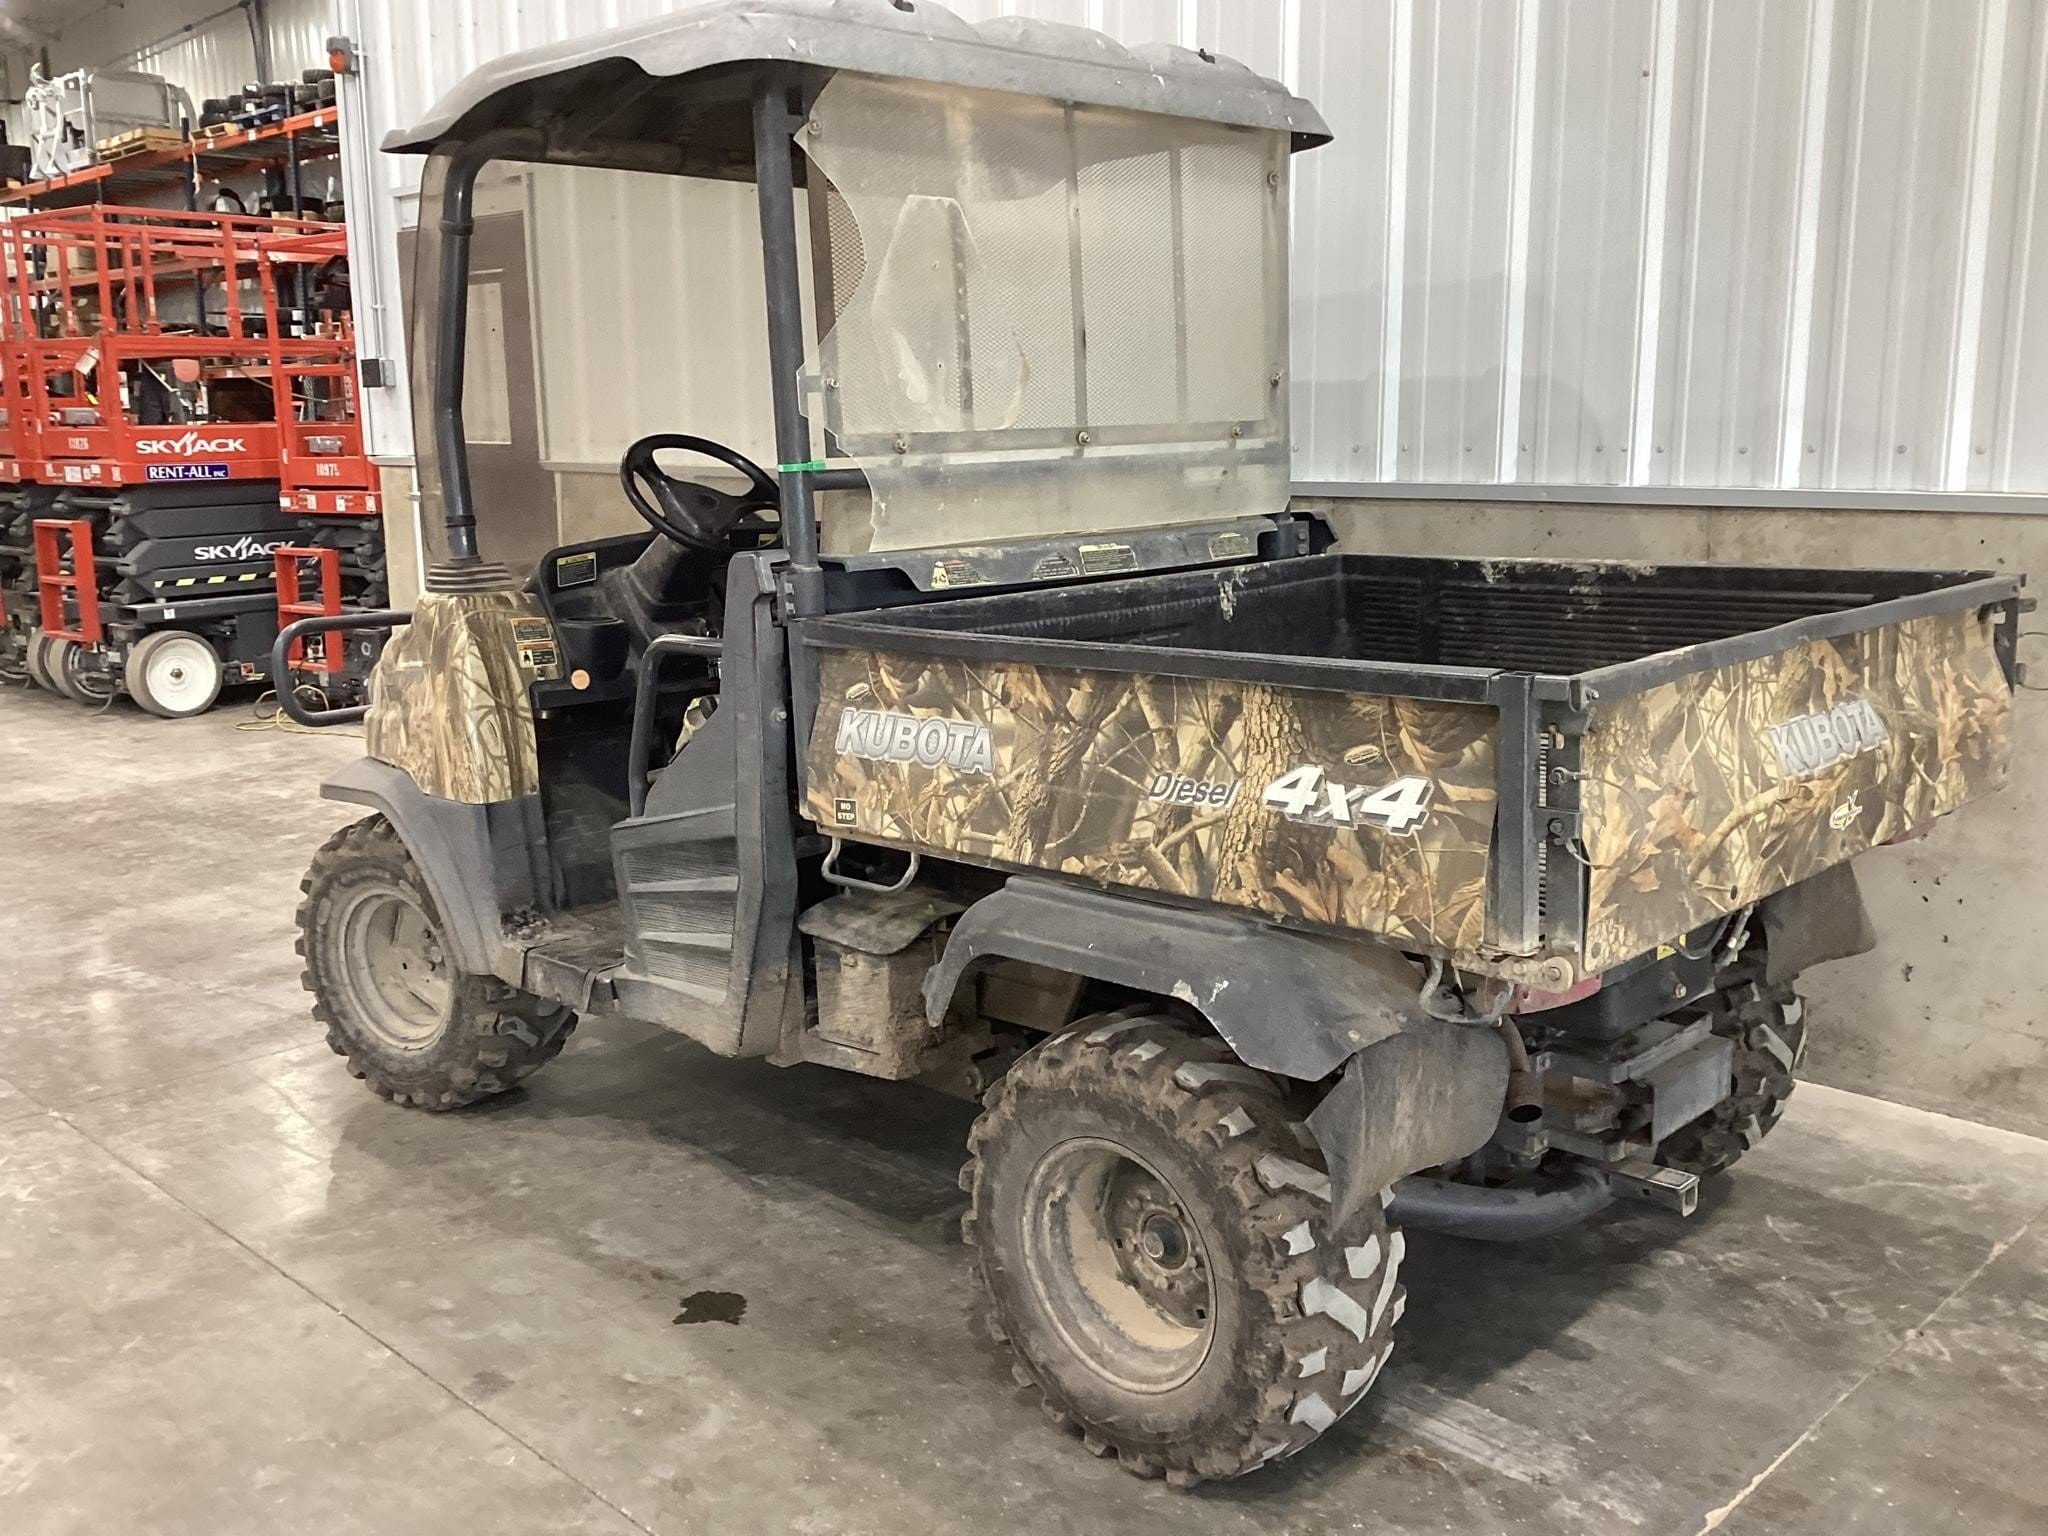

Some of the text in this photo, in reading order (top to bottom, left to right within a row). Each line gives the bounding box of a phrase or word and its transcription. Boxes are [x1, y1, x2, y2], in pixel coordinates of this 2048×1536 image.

[136, 431, 247, 457] SKYJACK
[149, 465, 212, 479] RENT-ALL
[835, 707, 995, 776] KUBOTA
[1769, 699, 1890, 779] KUBOTA
[840, 802, 851, 811] NO
[1150, 764, 1433, 836] Diesel 4x4
[837, 812, 855, 821] STEP
